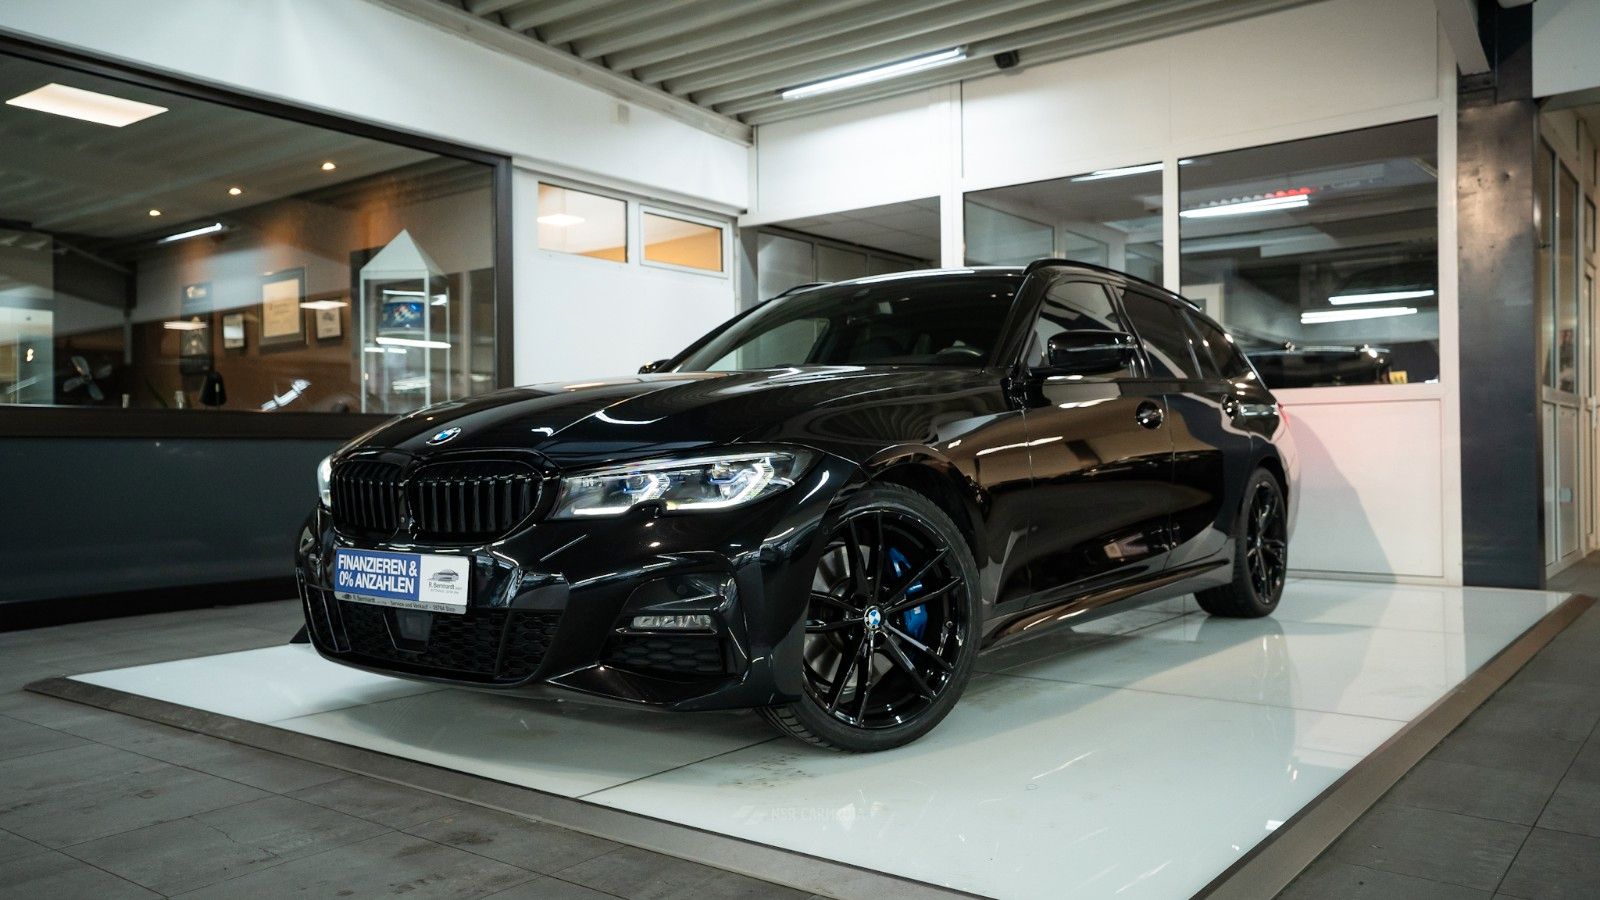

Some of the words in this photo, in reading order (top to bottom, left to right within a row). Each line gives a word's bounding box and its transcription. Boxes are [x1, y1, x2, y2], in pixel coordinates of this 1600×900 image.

[338, 554, 407, 576] FINANZIEREN
[408, 560, 418, 577] &
[339, 570, 354, 588] 0%
[355, 572, 414, 594] ANZAHLEN
